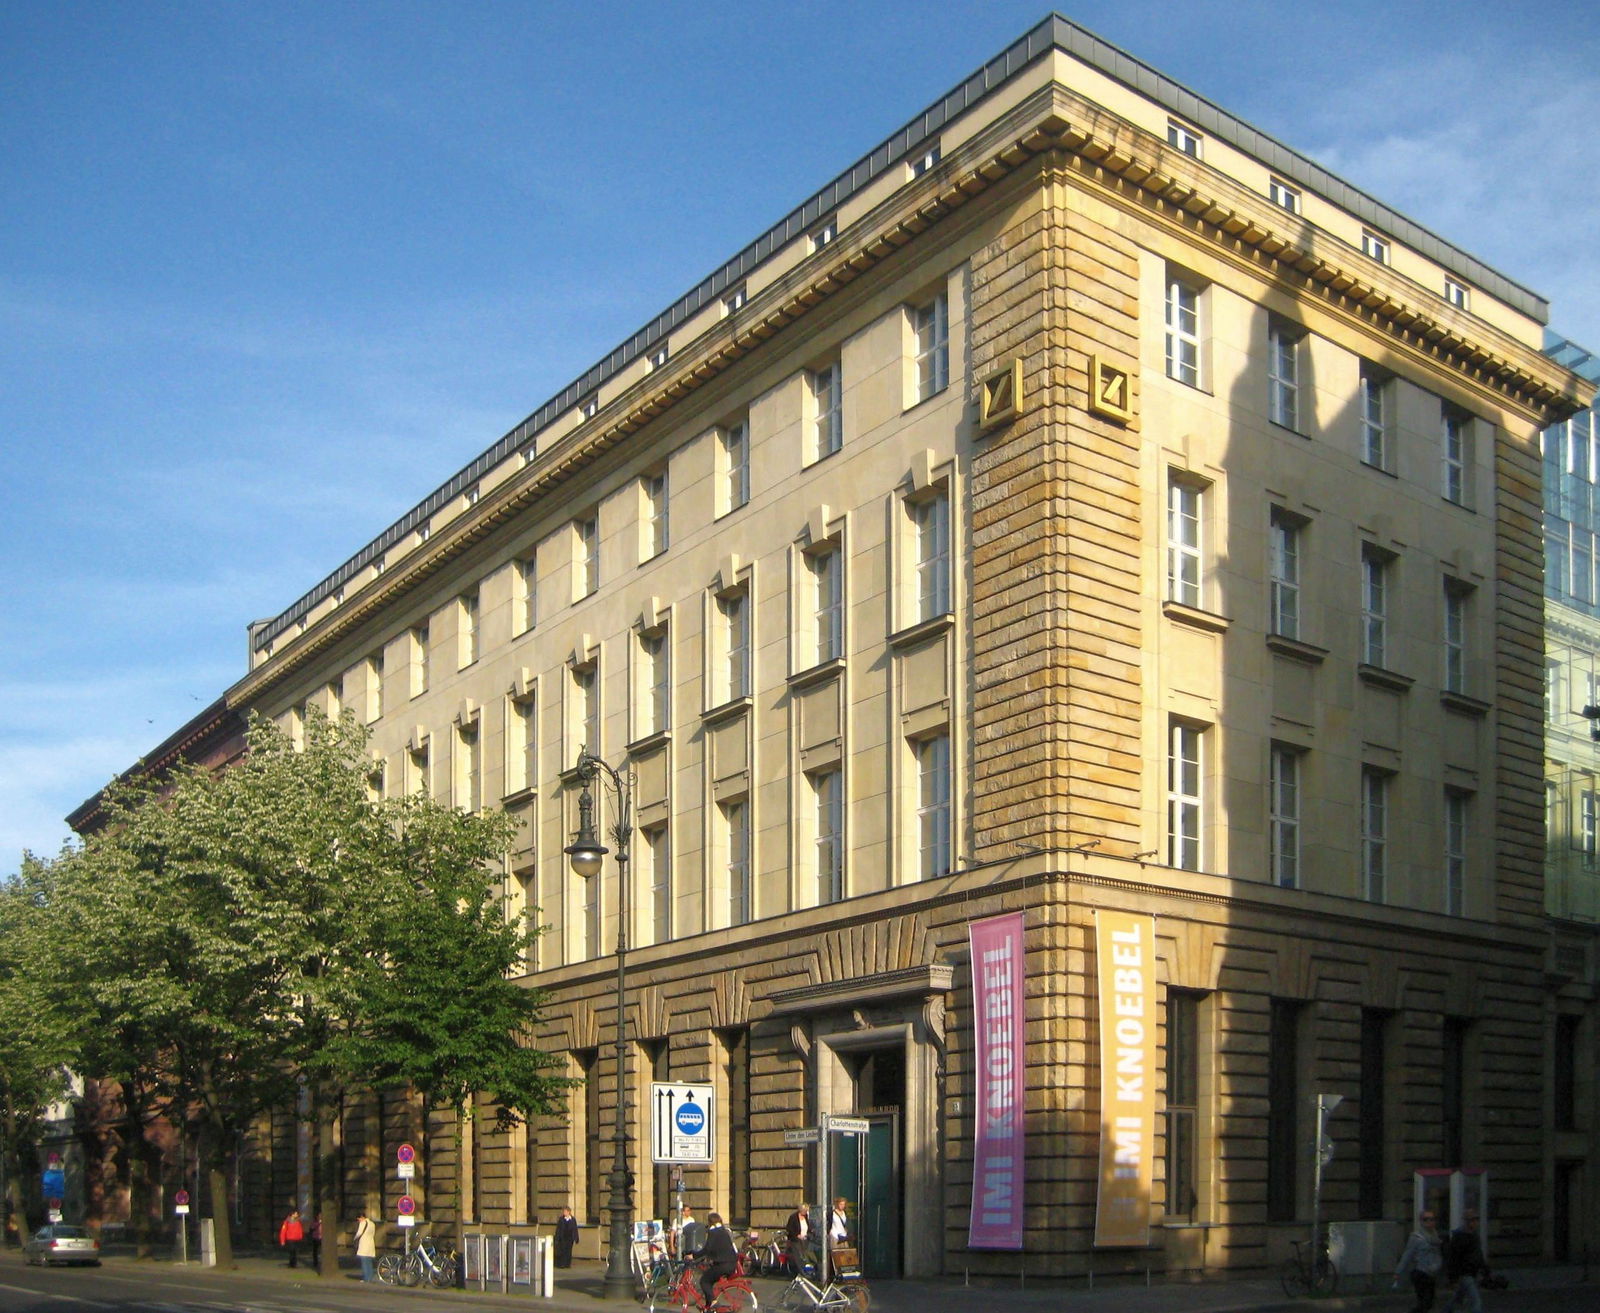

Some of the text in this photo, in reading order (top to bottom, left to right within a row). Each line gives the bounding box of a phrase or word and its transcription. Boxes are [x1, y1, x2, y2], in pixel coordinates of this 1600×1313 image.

[983, 935, 1014, 1140] KNOEBEL
[1112, 923, 1145, 1103] KNOEBEL
[982, 1155, 1013, 1225] IMI
[1113, 1117, 1142, 1179] IMI
